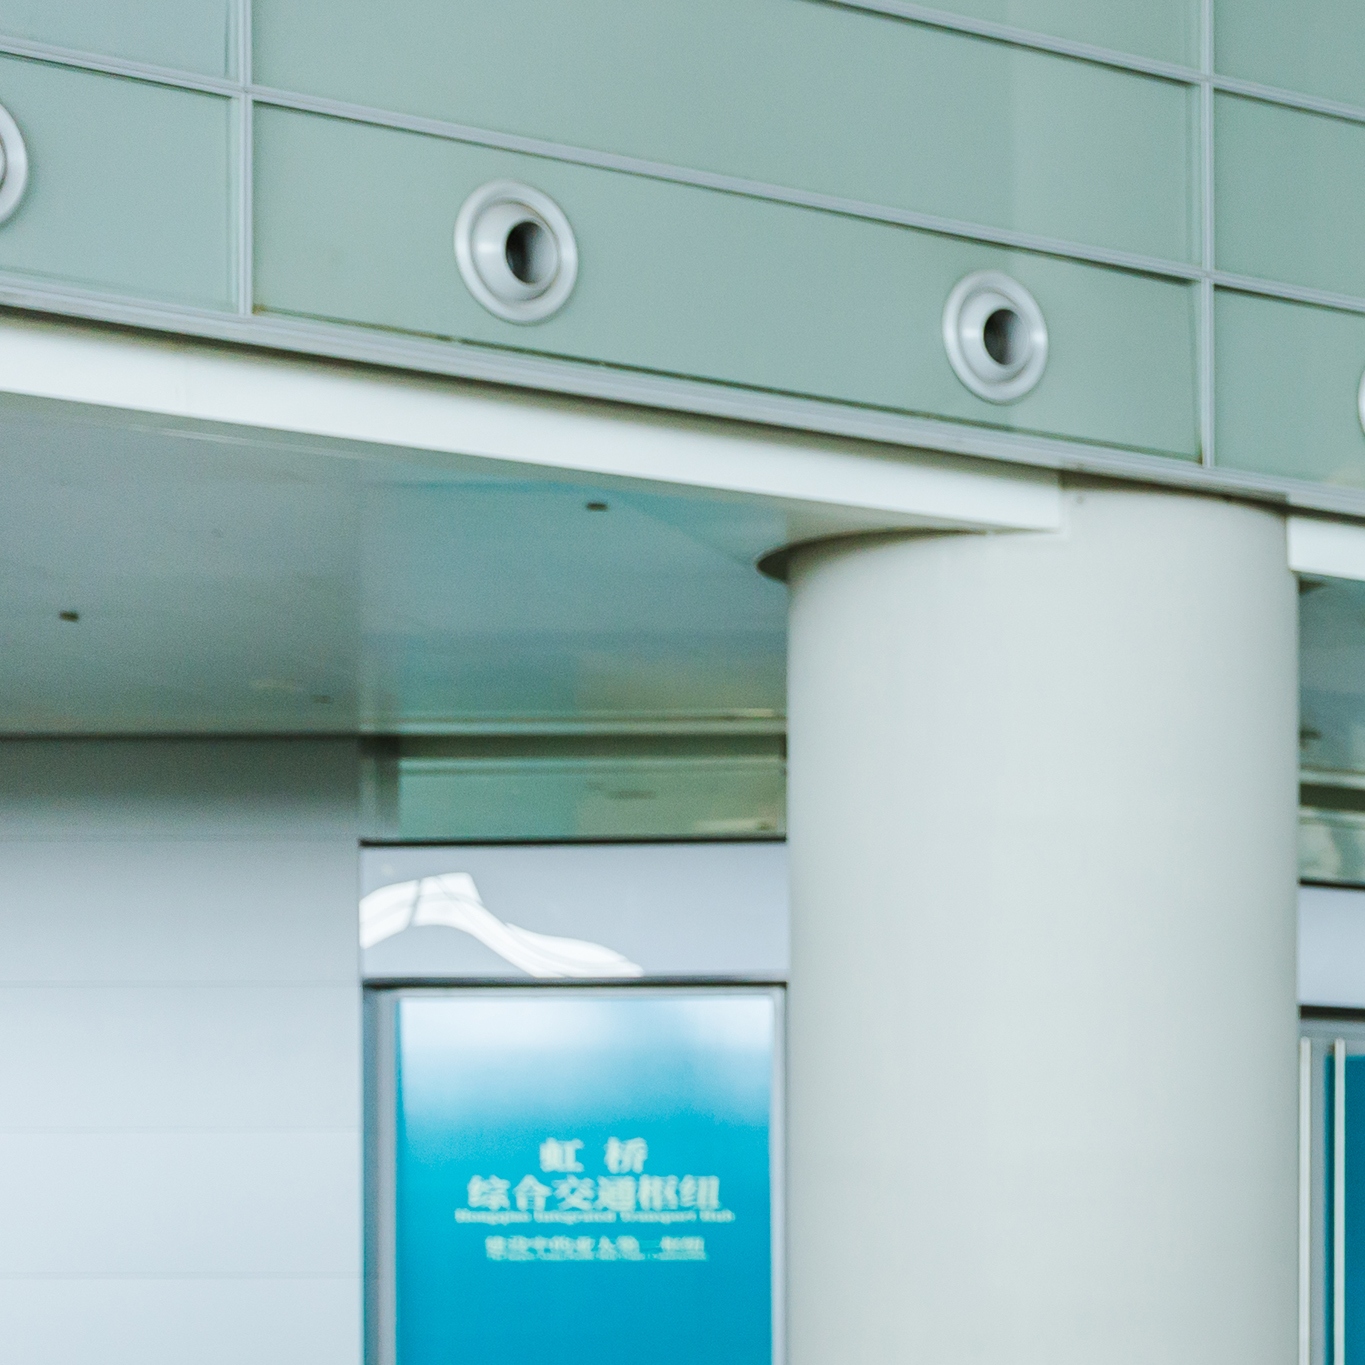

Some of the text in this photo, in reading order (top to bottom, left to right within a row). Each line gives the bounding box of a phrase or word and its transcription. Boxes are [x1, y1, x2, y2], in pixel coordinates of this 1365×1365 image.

[467, 1174, 721, 1211] 综合交通枢纽
